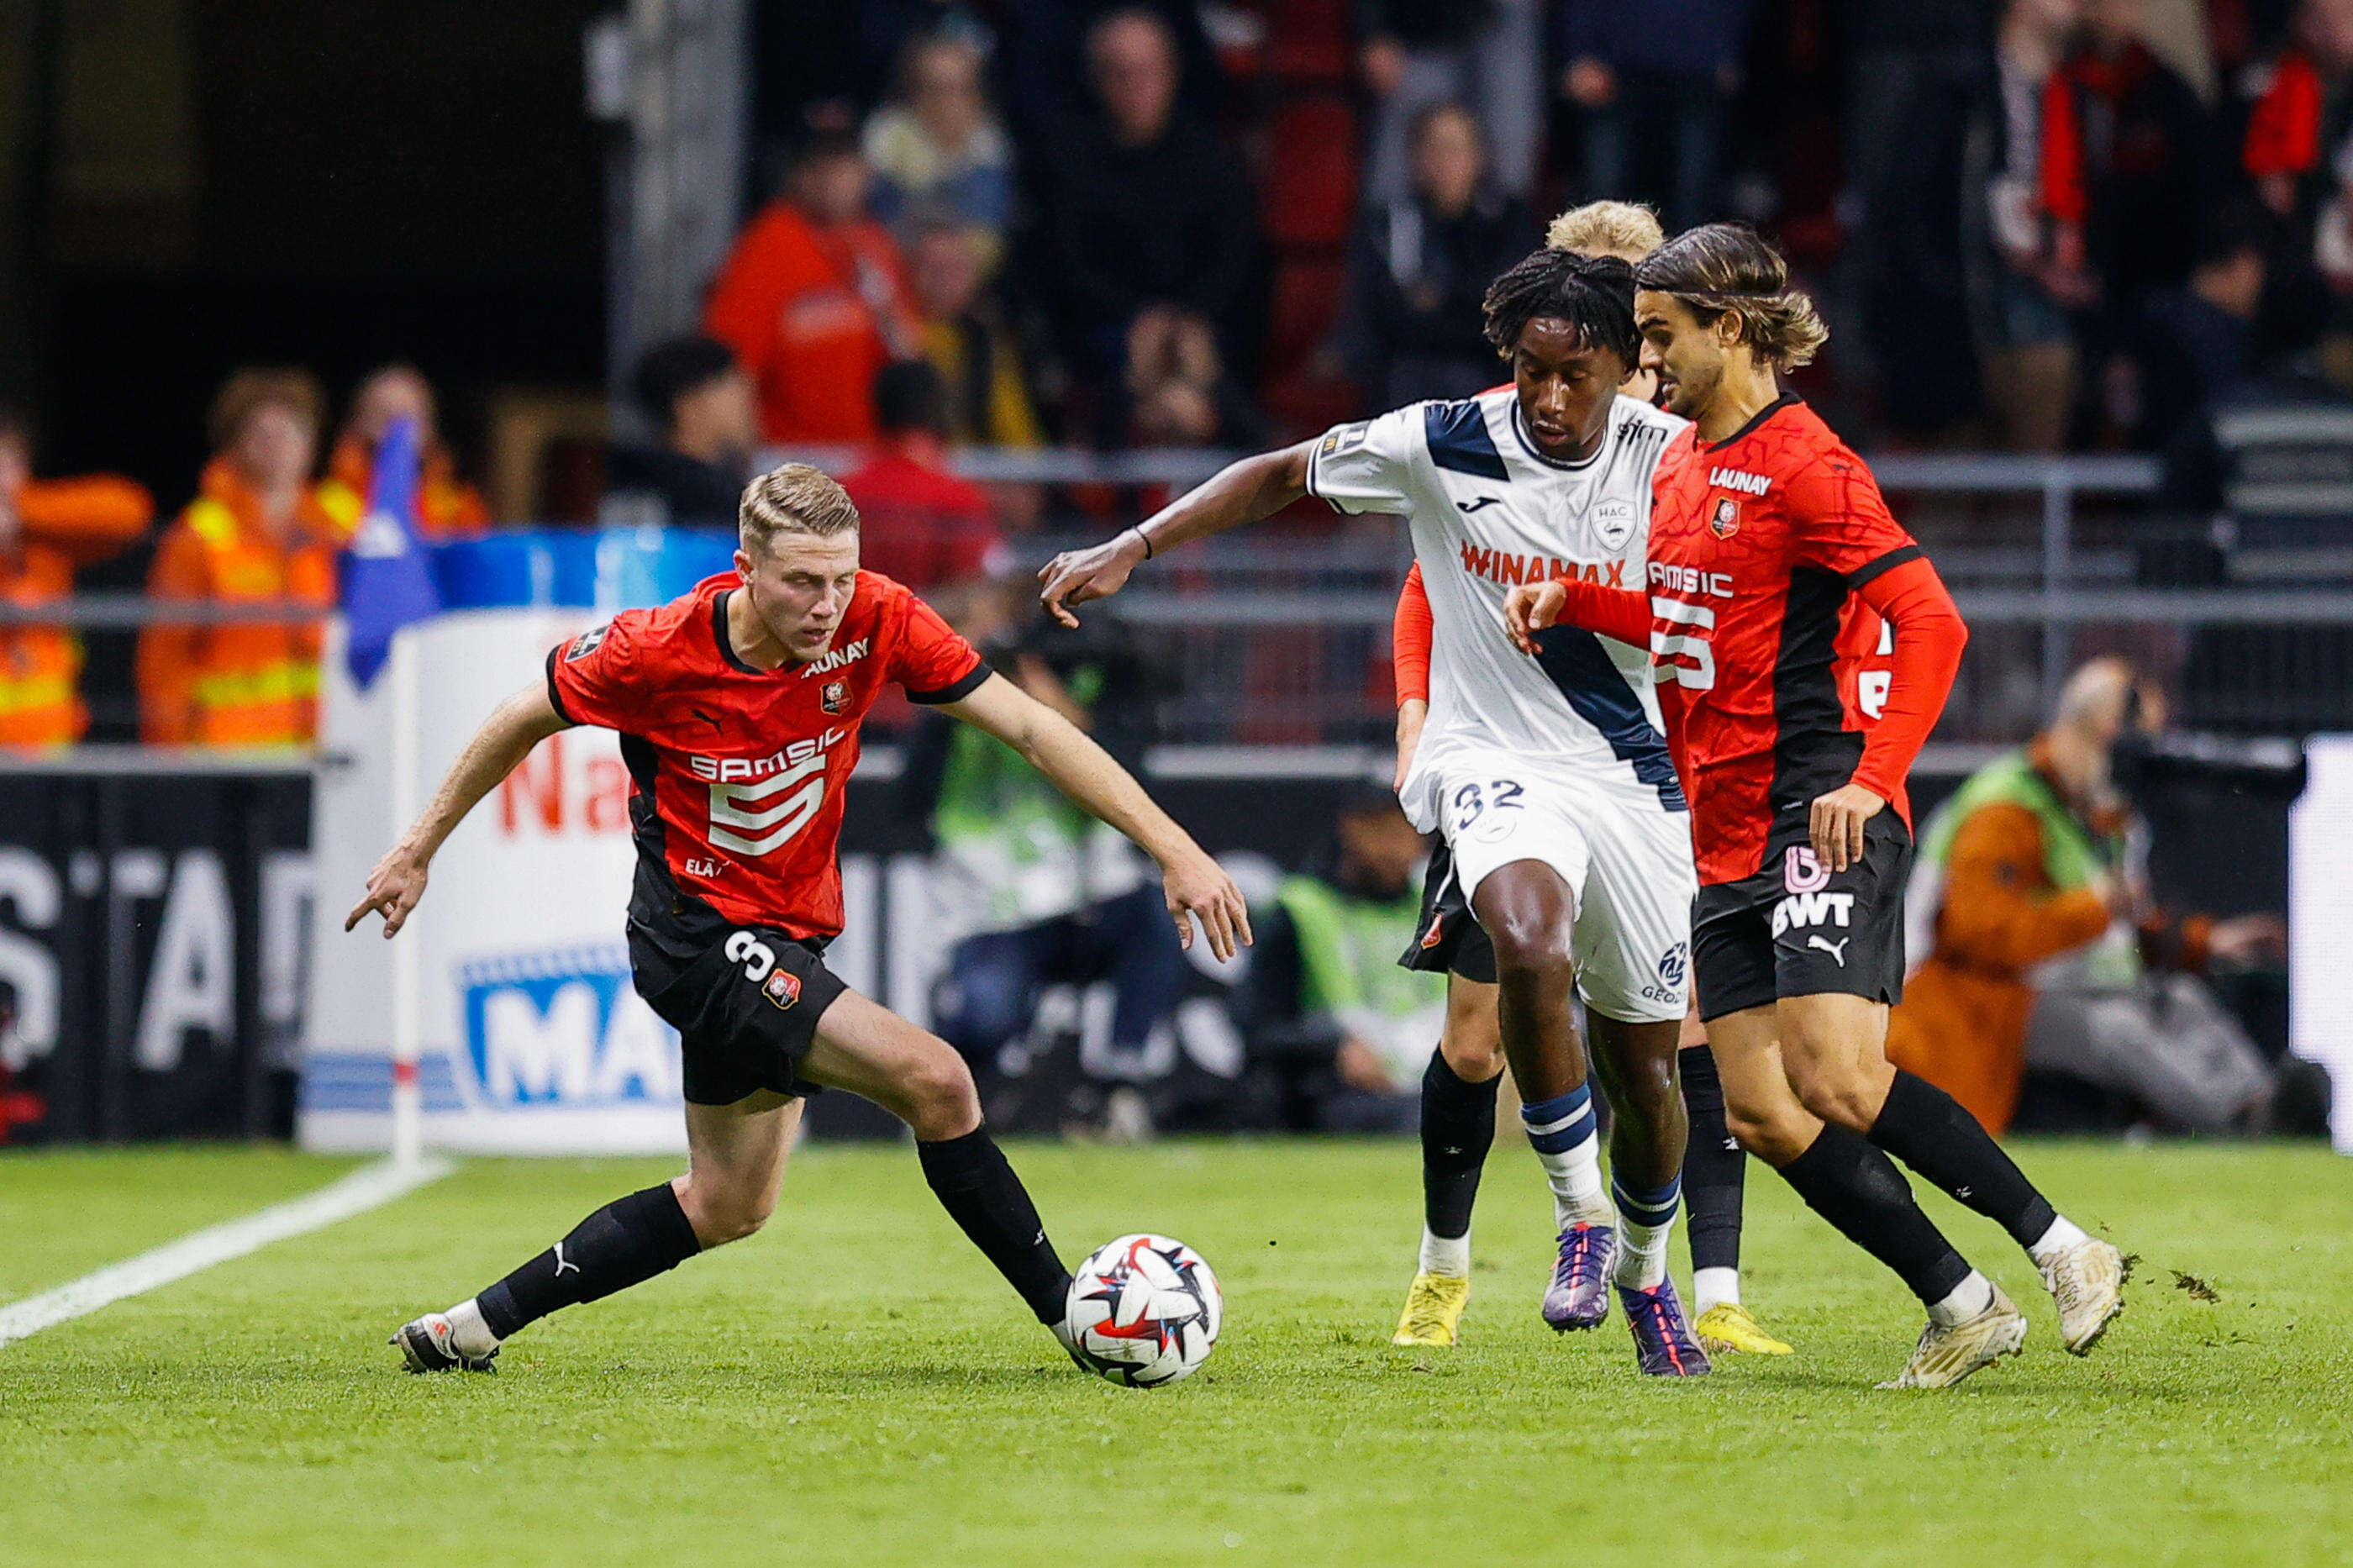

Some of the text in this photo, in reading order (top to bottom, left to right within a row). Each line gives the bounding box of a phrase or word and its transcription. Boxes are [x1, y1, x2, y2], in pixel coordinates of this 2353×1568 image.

[1708, 466, 1773, 496] LAUNAY
[1598, 506, 1628, 518] HAC
[1460, 539, 1626, 589] WINAMAX
[800, 637, 869, 680] AUNAY
[691, 726, 845, 783] SAMSIC
[1455, 780, 1525, 830] 32
[1771, 892, 1855, 940] BWT
[725, 930, 776, 982] 3
